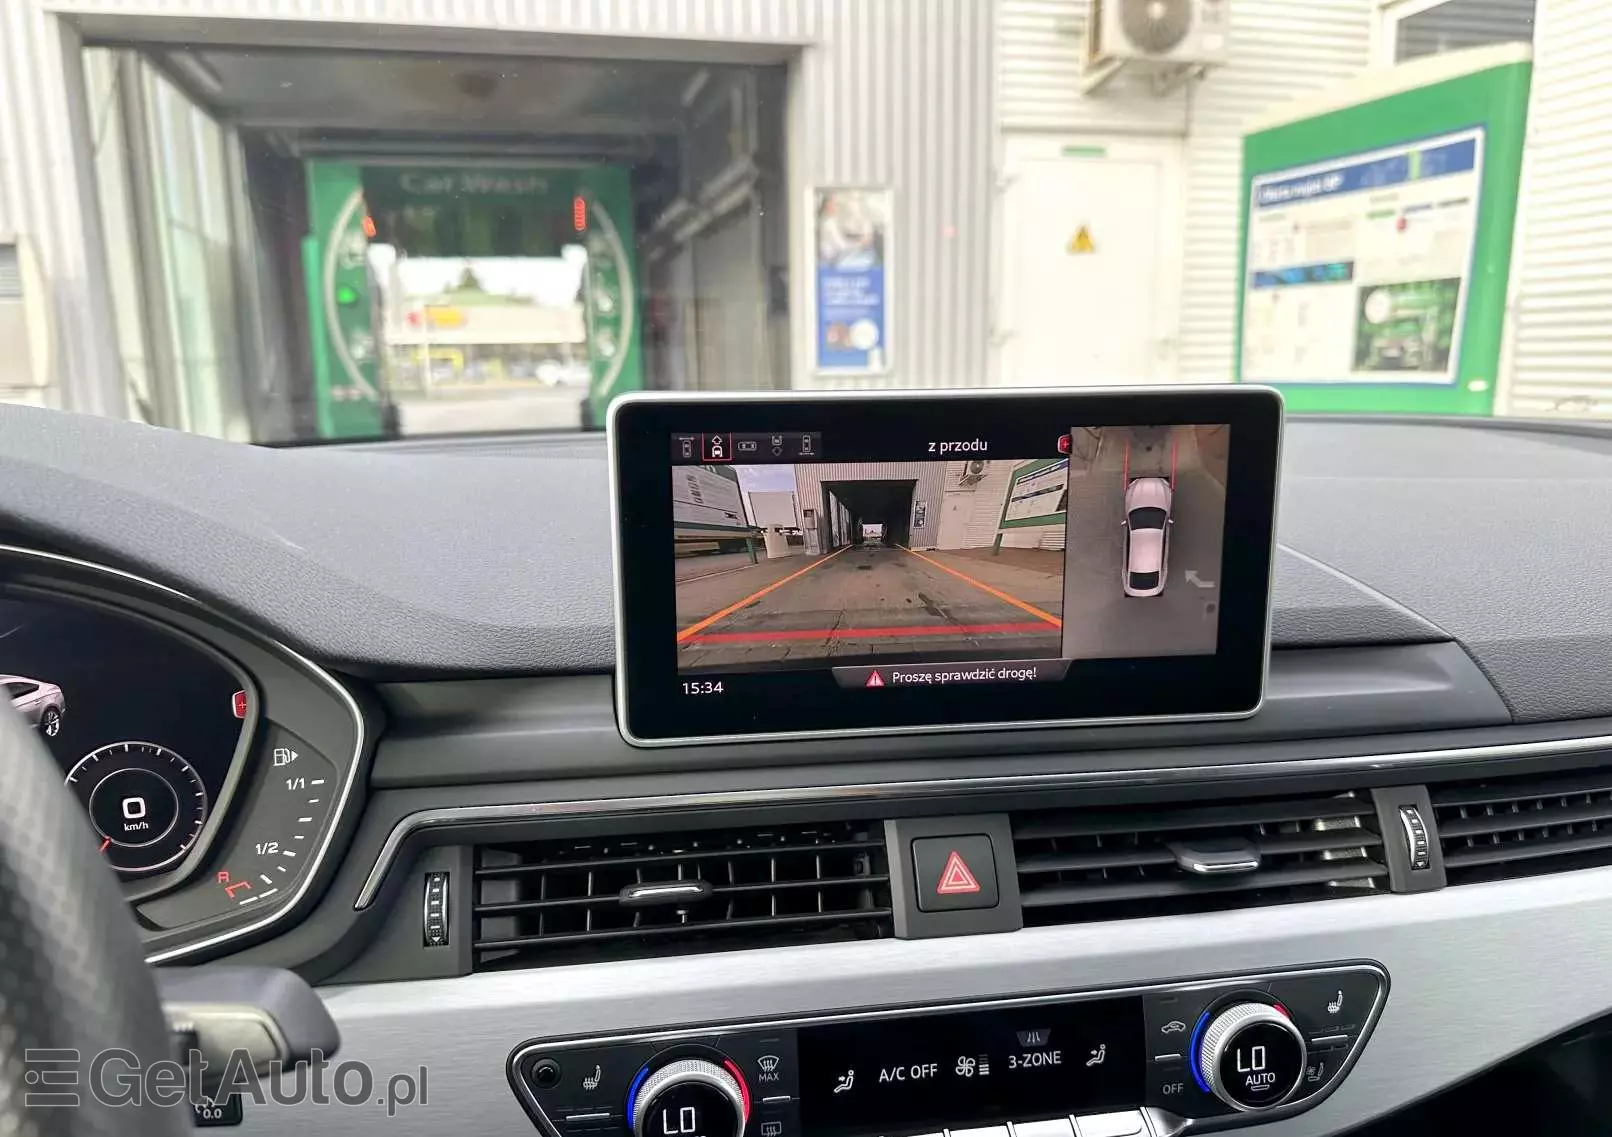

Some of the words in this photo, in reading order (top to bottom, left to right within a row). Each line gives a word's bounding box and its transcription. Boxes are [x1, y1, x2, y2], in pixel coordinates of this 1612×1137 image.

[928, 442, 937, 452] z
[940, 438, 988, 455] przodu
[892, 671, 932, 684] Proszę
[935, 667, 996, 684] sprawdzić
[998, 666, 1037, 681] drogę!
[682, 679, 725, 696] 15:34
[286, 778, 306, 790] 1/1
[122, 797, 146, 819] 0
[123, 821, 149, 832] km/h
[255, 841, 279, 855] 1/2
[1008, 1050, 1062, 1069] 3-ZONE
[1236, 1045, 1267, 1073] LO
[758, 1072, 780, 1083] MAX
[879, 1067, 906, 1082] A/C
[910, 1063, 938, 1079] OFF
[1245, 1072, 1276, 1086] AUTO
[1162, 1082, 1185, 1096] OFF
[203, 1108, 222, 1119] 0.0
[663, 1107, 695, 1134] LO
